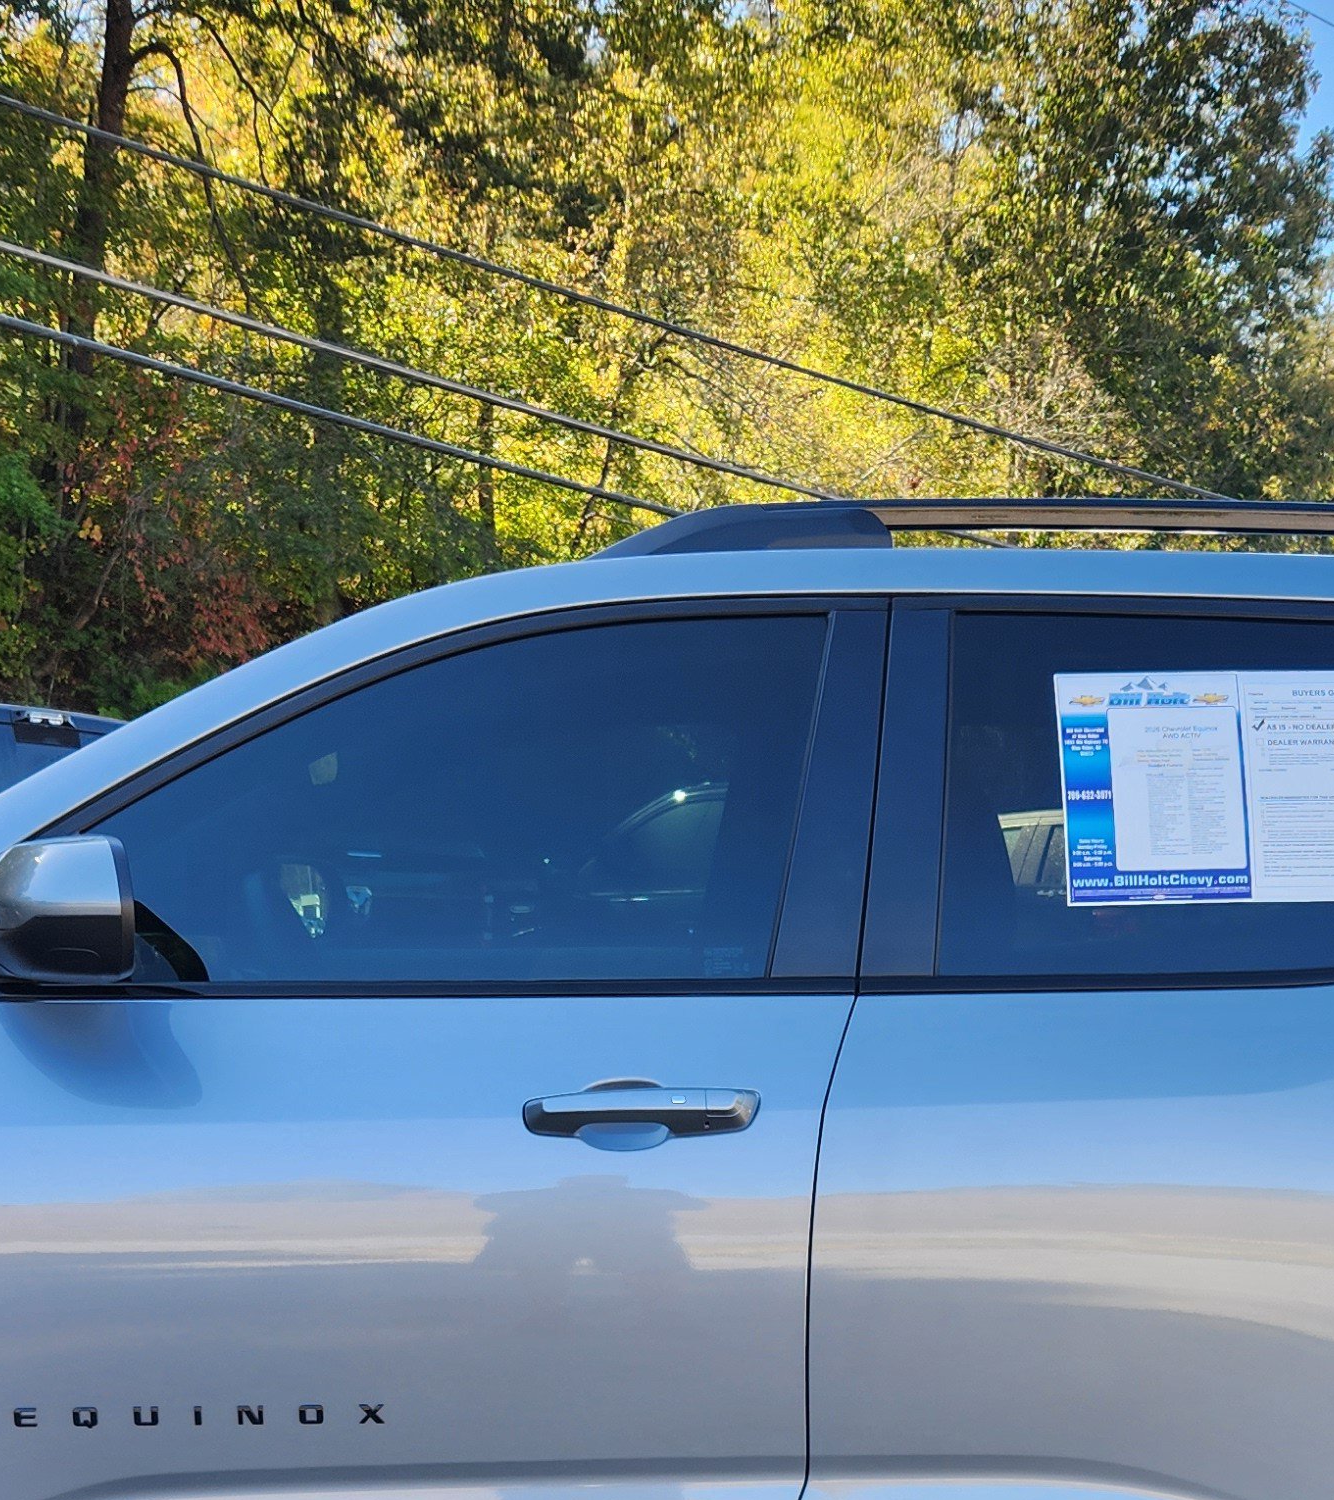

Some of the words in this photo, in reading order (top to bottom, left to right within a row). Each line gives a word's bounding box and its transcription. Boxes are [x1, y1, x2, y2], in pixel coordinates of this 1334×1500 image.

[1291, 689, 1326, 697] BUYERS
[1267, 723, 1278, 731] AS
[1279, 723, 1286, 731] IS
[1072, 873, 1249, 888] www.BillHoltChevy.com
[13, 1403, 385, 1429] EQUINOX
